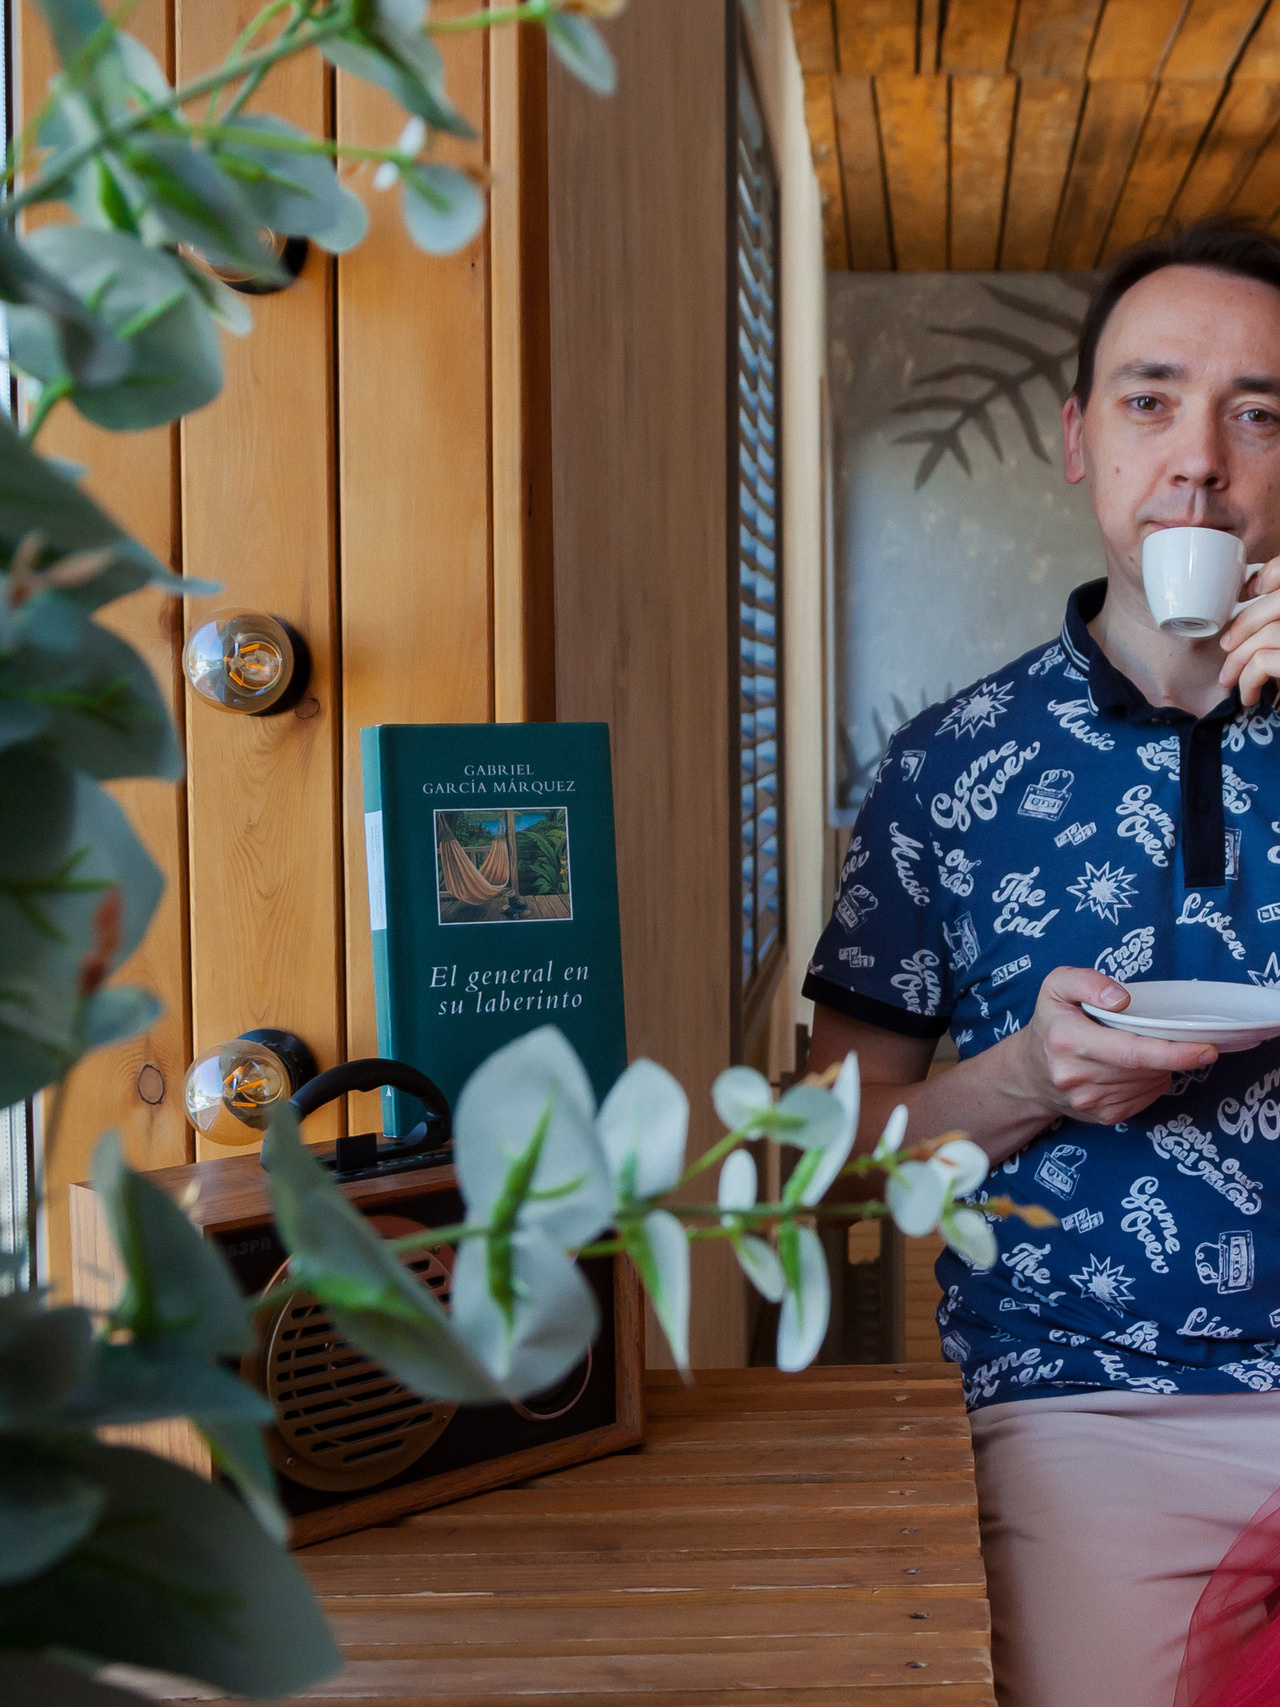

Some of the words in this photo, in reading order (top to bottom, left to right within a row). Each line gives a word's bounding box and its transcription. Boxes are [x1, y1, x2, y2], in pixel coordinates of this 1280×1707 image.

[422, 778, 487, 795] GARCÍA
[493, 777, 576, 795] MÁRQUEZ
[464, 764, 534, 776] GABRIEL
[931, 740, 1018, 832] Game
[971, 741, 1040, 820] Over
[1116, 784, 1176, 850] Game
[1117, 815, 1169, 867] Over
[992, 866, 1046, 907] The
[993, 902, 1060, 938] End
[1175, 893, 1246, 960] Listen
[429, 964, 456, 988] El
[465, 960, 553, 993] general
[564, 963, 589, 982] en
[438, 997, 463, 1015] su
[476, 991, 583, 1013] laberinto
[1121, 1175, 1180, 1254] Game
[1001, 1242, 1051, 1284] The
[1121, 1210, 1169, 1274] Over
